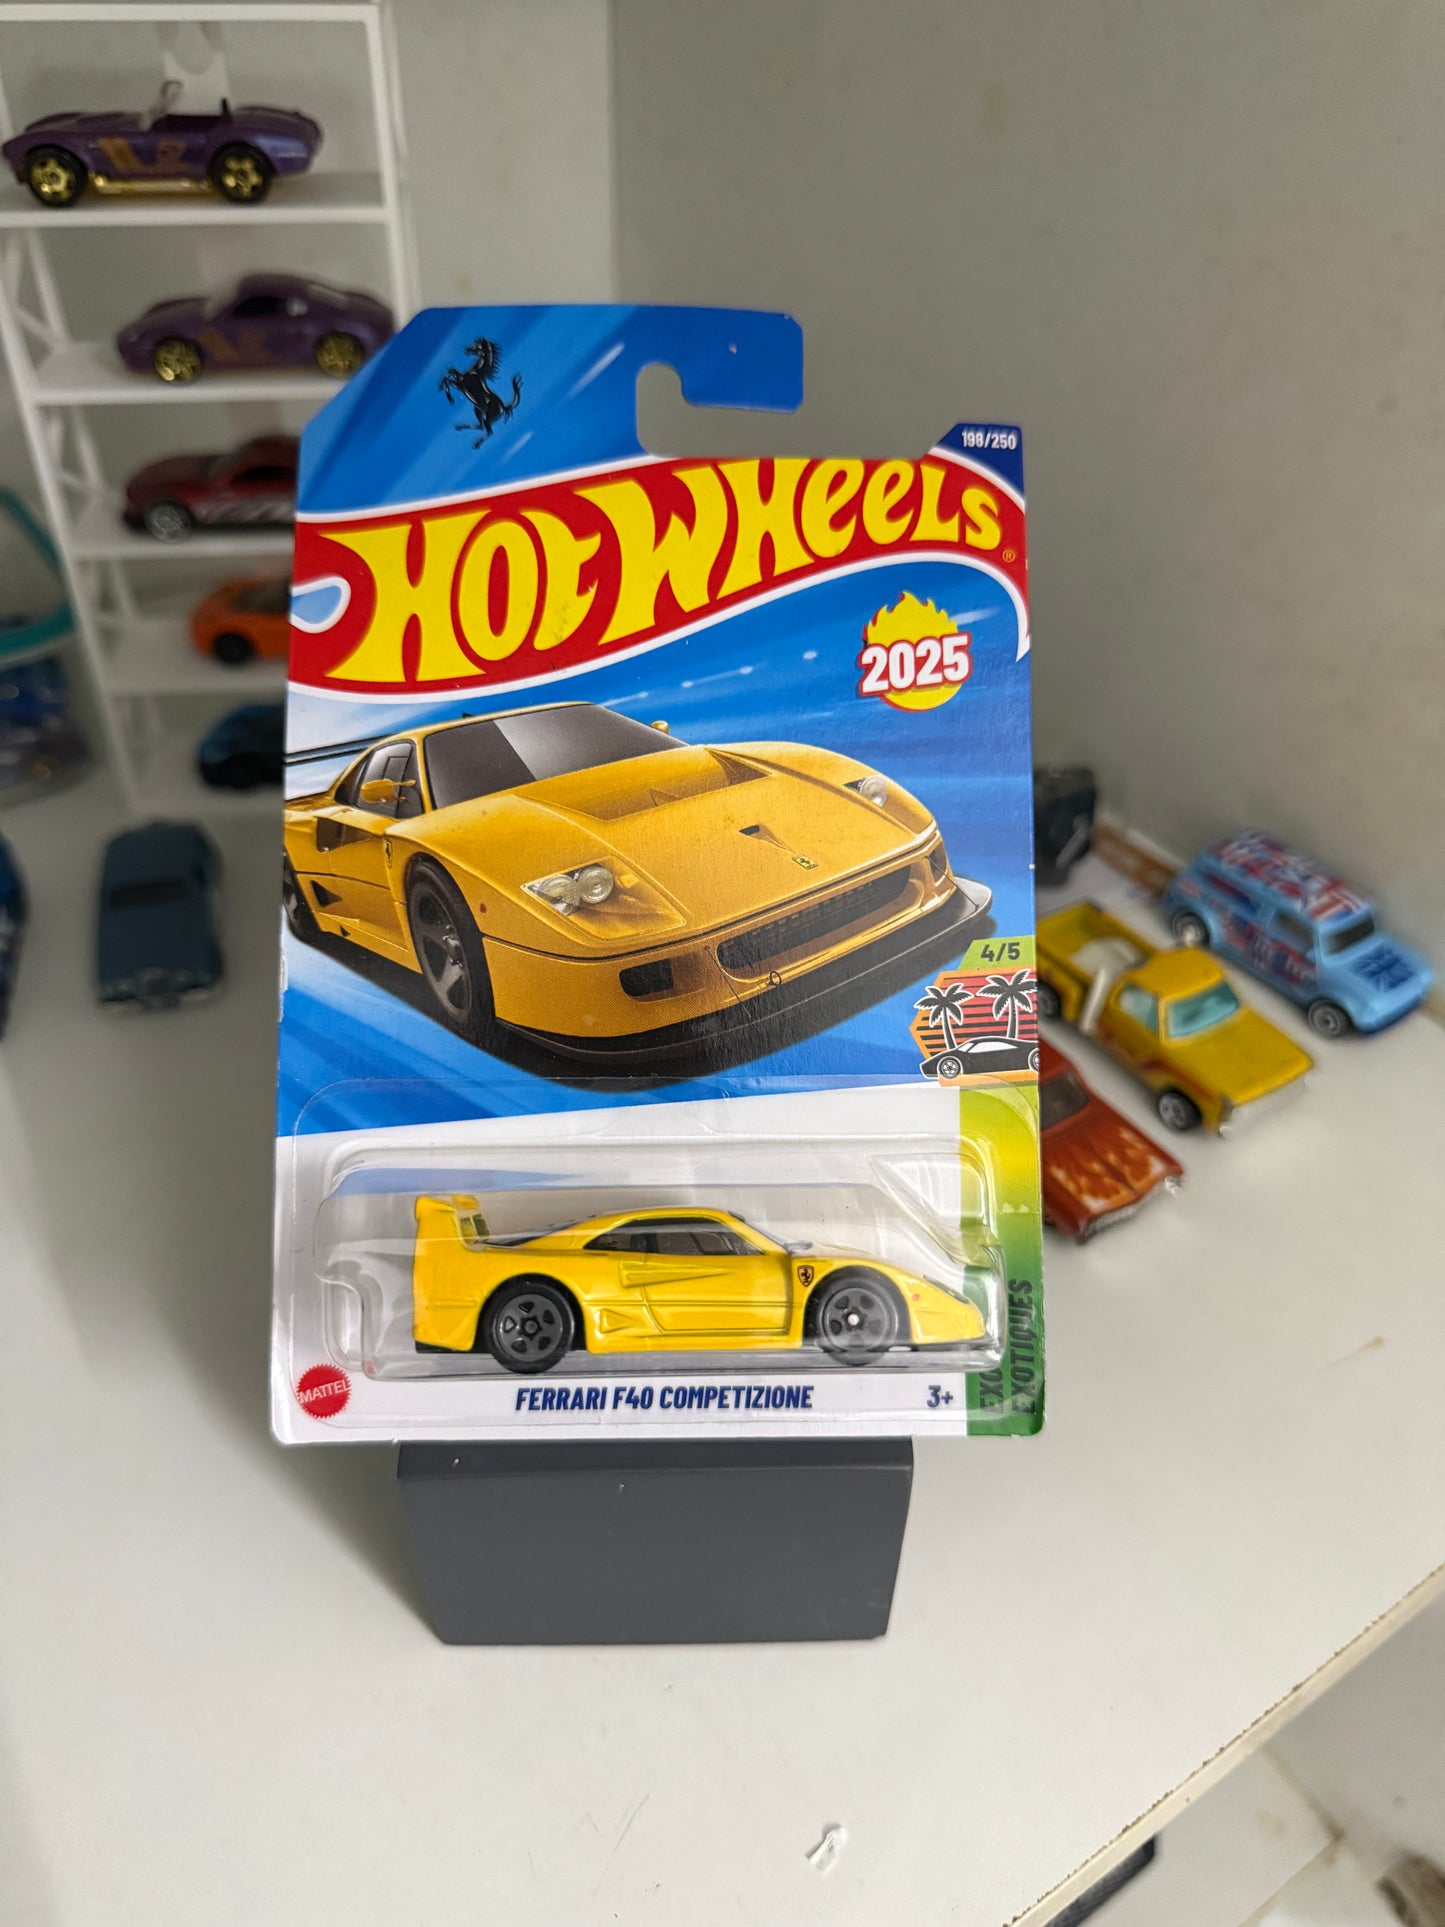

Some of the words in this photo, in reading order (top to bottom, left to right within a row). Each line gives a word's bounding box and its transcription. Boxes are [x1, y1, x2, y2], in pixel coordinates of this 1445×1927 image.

[961, 430, 1017, 450] 198/250
[860, 634, 971, 694] 2025
[980, 942, 1020, 963] 4/5
[1008, 1278, 1037, 1414] EXOTIQUES
[299, 1379, 352, 1404] MATTEL
[515, 1386, 608, 1411] FERRARI
[612, 1385, 654, 1410] F40
[659, 1385, 815, 1410] COMPETIZIONE
[926, 1384, 954, 1408] 3+
